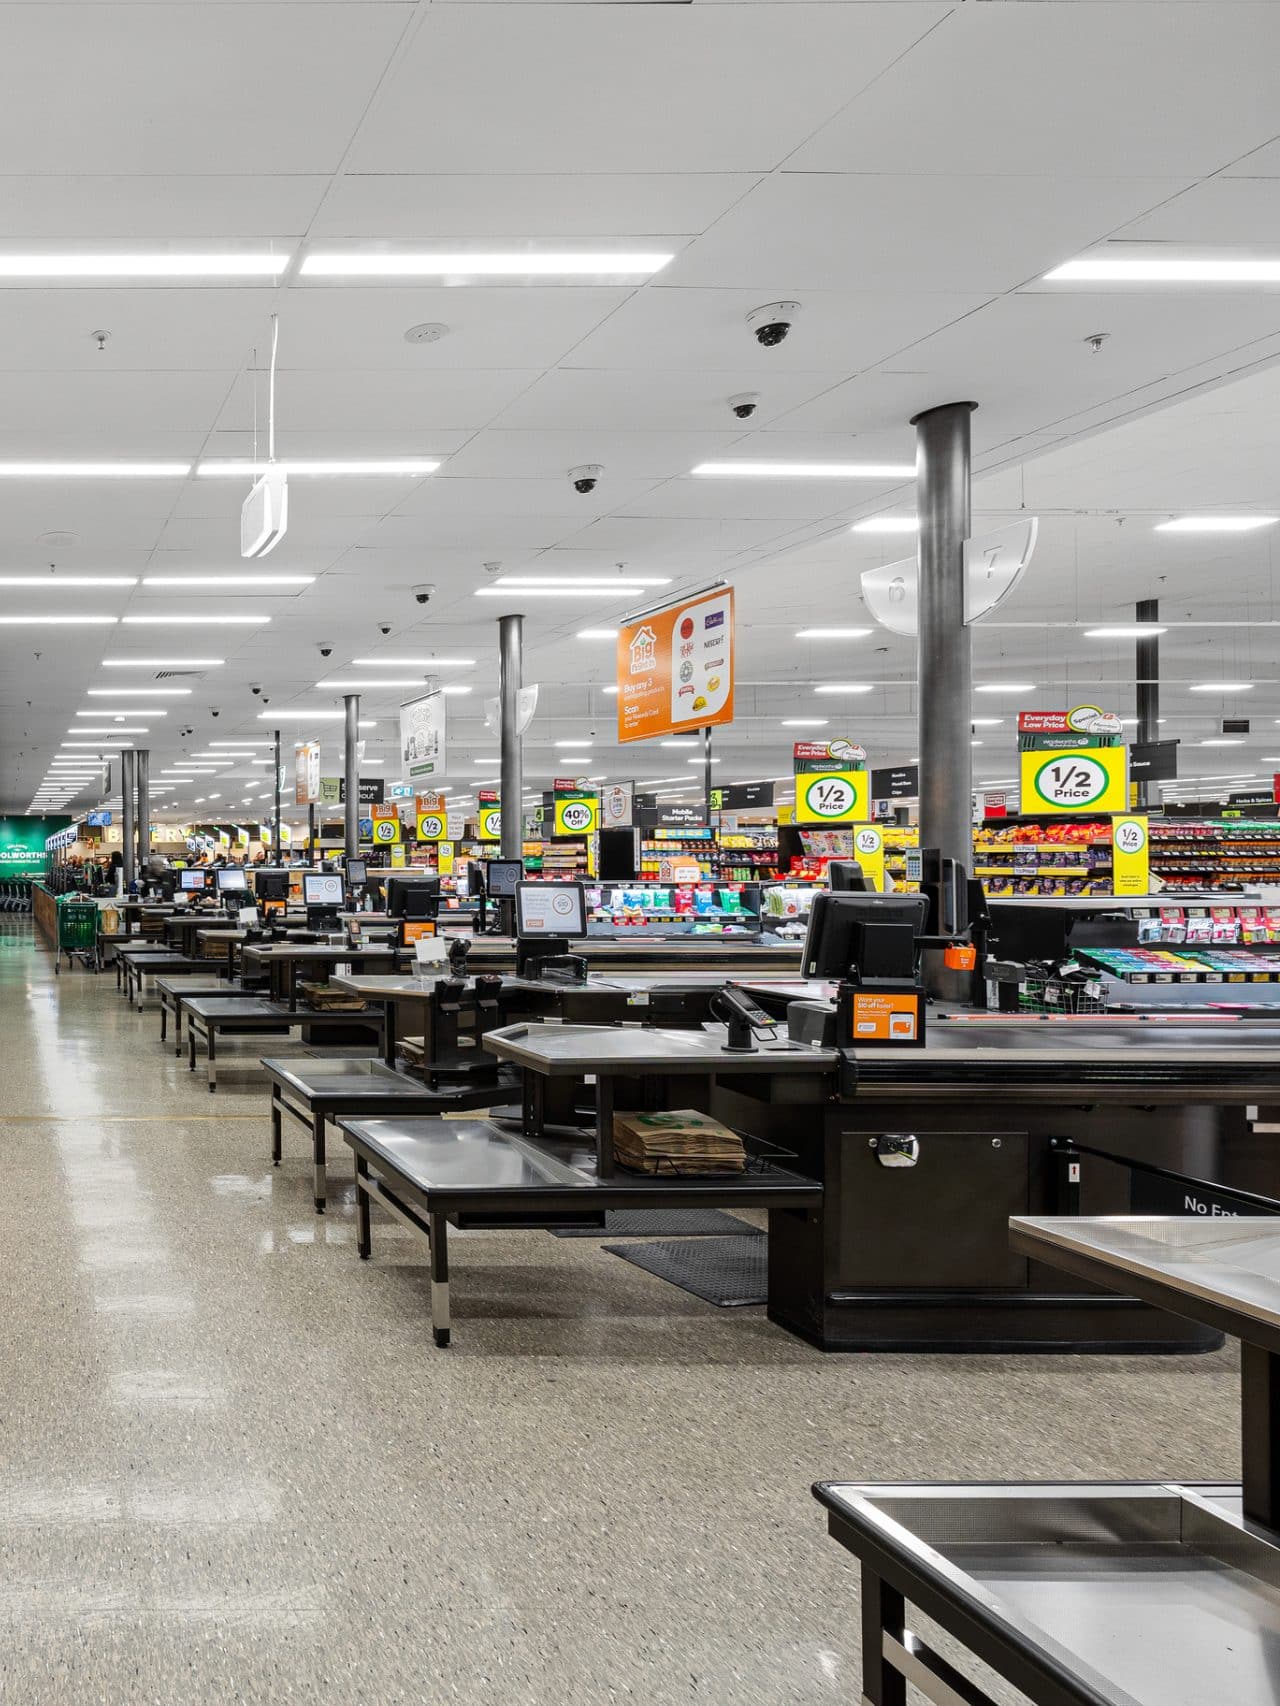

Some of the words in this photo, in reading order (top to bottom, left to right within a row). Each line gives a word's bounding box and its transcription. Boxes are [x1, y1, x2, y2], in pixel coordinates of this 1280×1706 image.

[984, 545, 1003, 578] 7
[1024, 714, 1066, 722] Everyday
[1023, 721, 1042, 729] Low
[1043, 721, 1065, 729] Price
[1051, 766, 1092, 788] 1/2
[817, 785, 845, 802] 1/2
[1054, 789, 1090, 798] Price
[565, 809, 590, 820] 40%
[425, 820, 438, 830] 1/2
[862, 835, 875, 844] 1/2
[1122, 829, 1138, 841] 1/2
[1184, 1195, 1208, 1215] No
